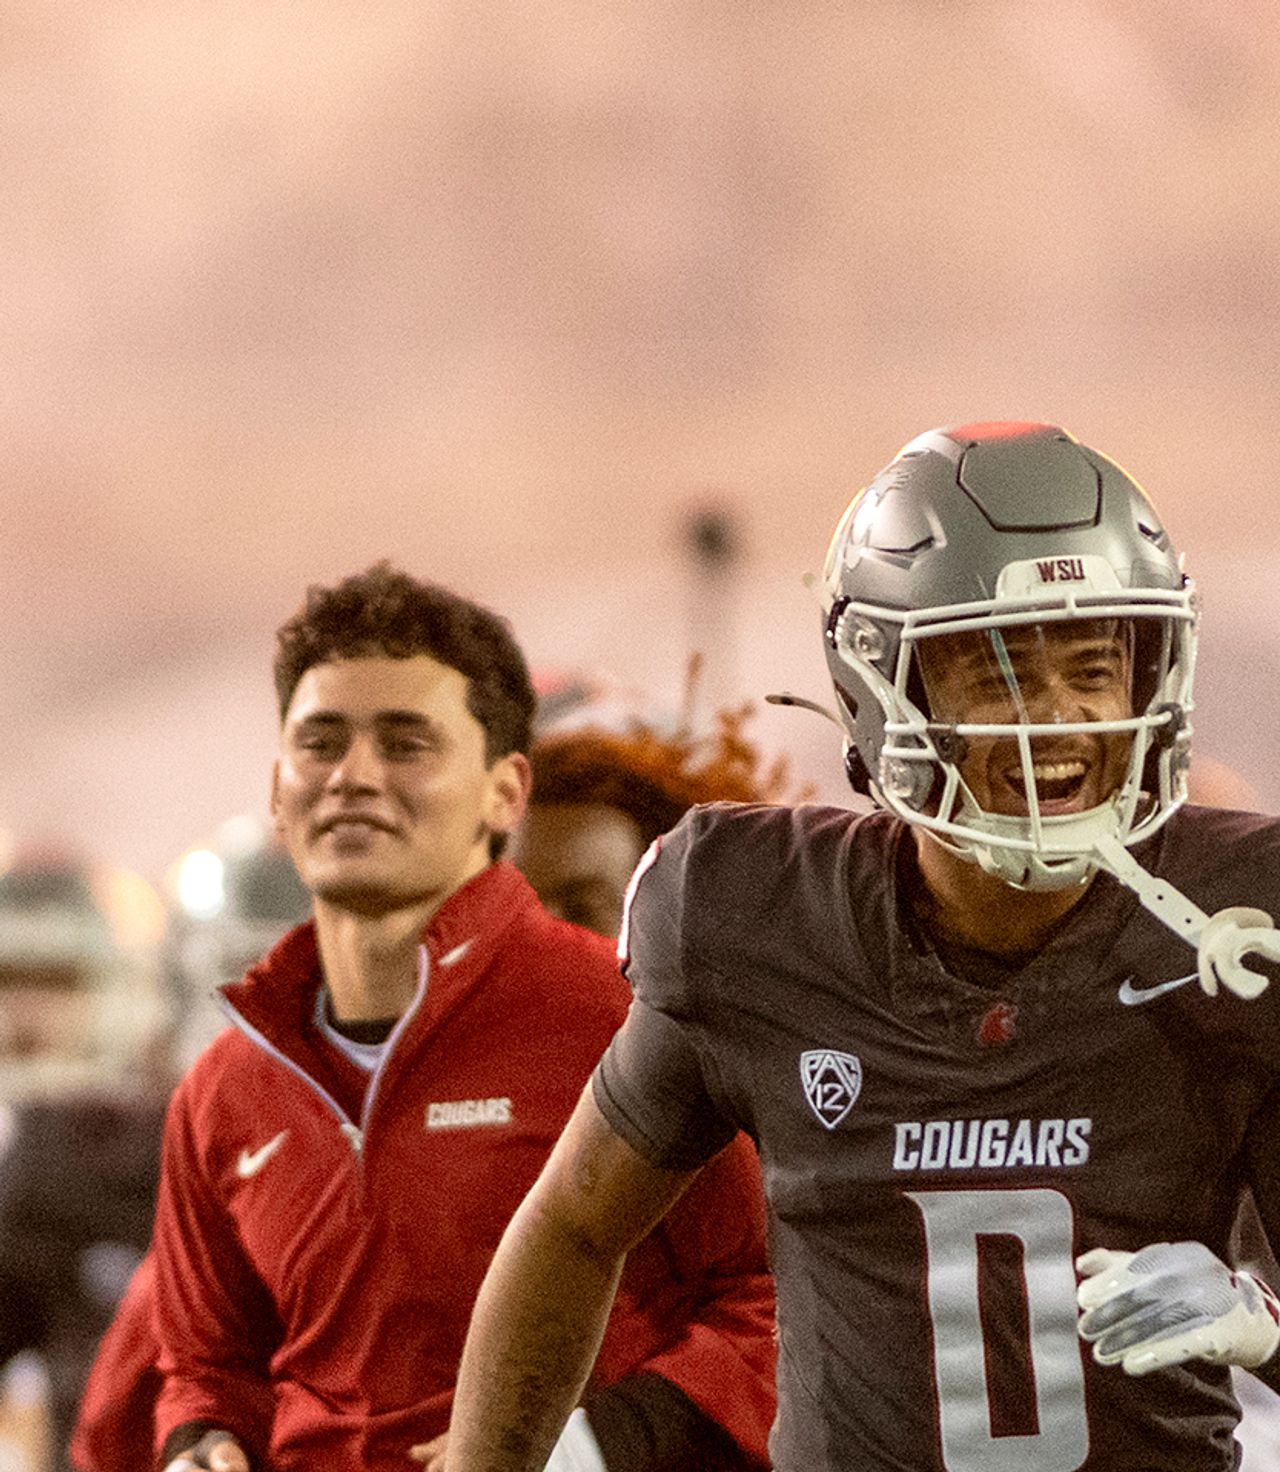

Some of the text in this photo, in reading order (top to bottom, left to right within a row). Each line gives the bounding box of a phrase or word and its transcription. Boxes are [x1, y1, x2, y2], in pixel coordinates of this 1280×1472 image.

[1036, 559, 1085, 583] WSU
[803, 1053, 858, 1096] PAC
[816, 1083, 846, 1110] 12
[426, 1097, 512, 1129] COUGARS
[892, 1118, 1092, 1170] COUGARS
